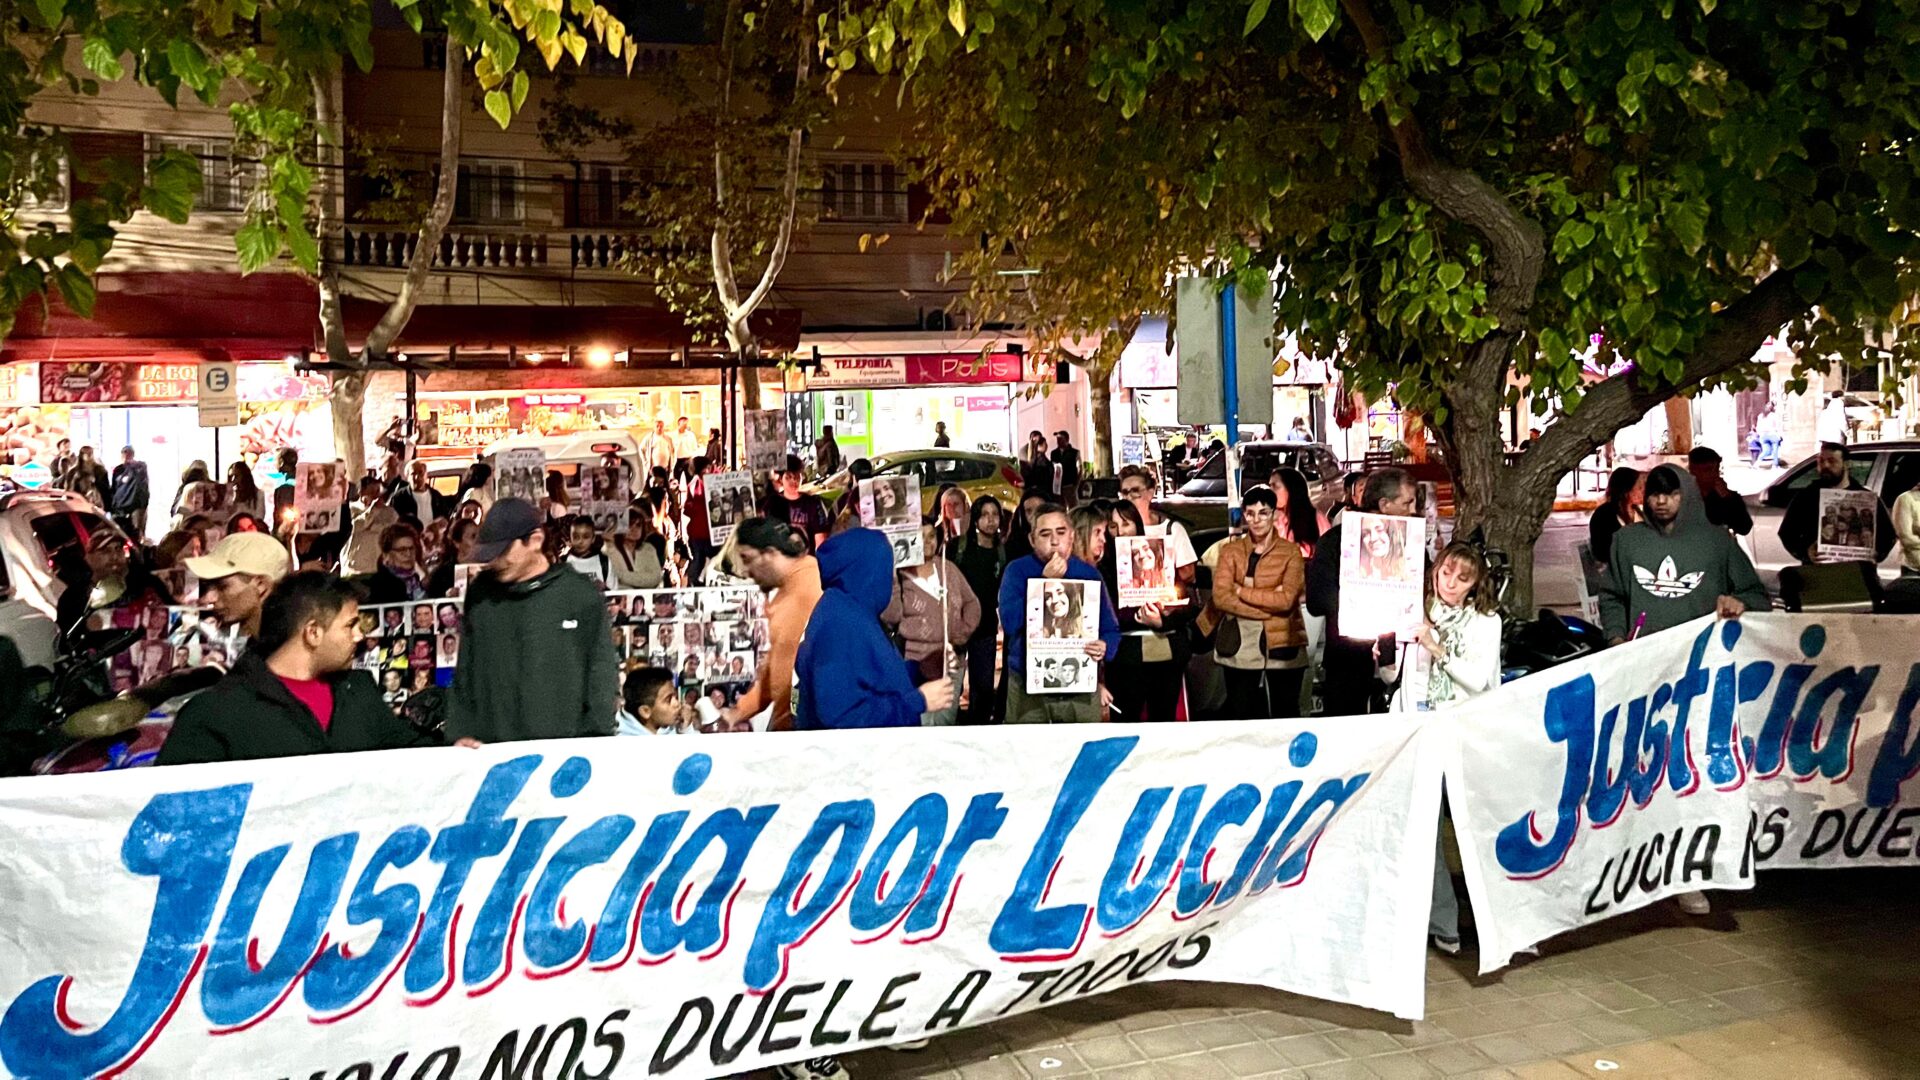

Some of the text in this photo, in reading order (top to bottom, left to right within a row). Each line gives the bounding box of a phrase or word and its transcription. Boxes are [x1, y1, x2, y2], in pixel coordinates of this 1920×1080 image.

[208, 368, 228, 391] E
[0, 731, 1372, 1080] Justicia por Lucia
[1584, 823, 1721, 916] LUCIA
[1800, 806, 1920, 858] DUE
[476, 1009, 631, 1080] NOS
[648, 970, 921, 1076] DUELE
[925, 969, 992, 1031] A
[998, 921, 1220, 1018] TODOS
